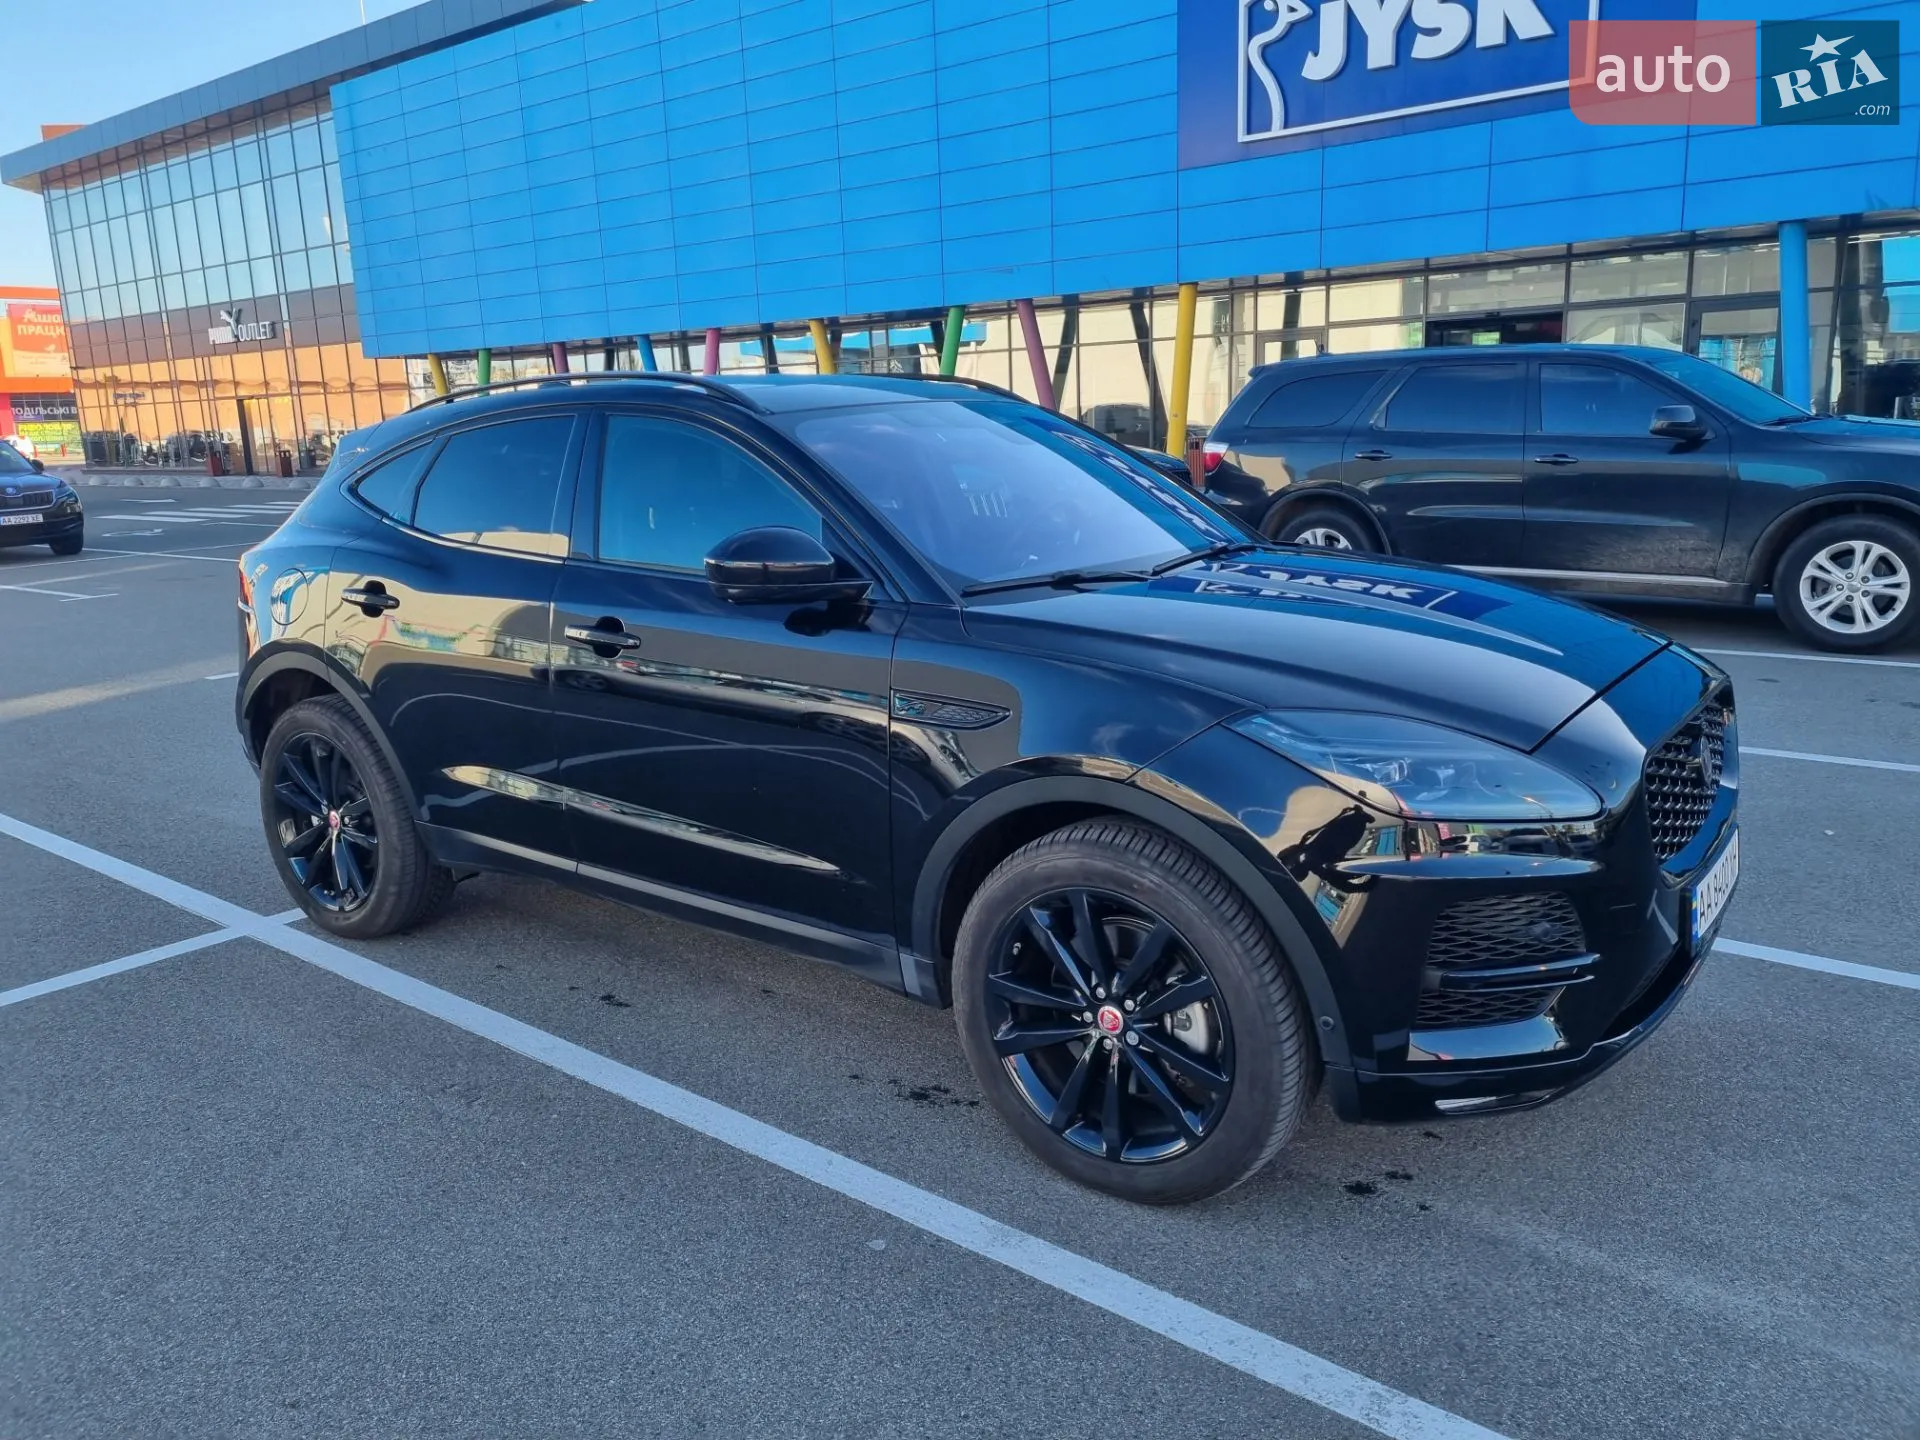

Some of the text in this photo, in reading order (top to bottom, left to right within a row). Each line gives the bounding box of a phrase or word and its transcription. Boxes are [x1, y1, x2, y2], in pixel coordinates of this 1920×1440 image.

[1301, 0, 1555, 81] JYSK
[23, 308, 64, 323] Аша
[238, 321, 270, 342] OUTLET
